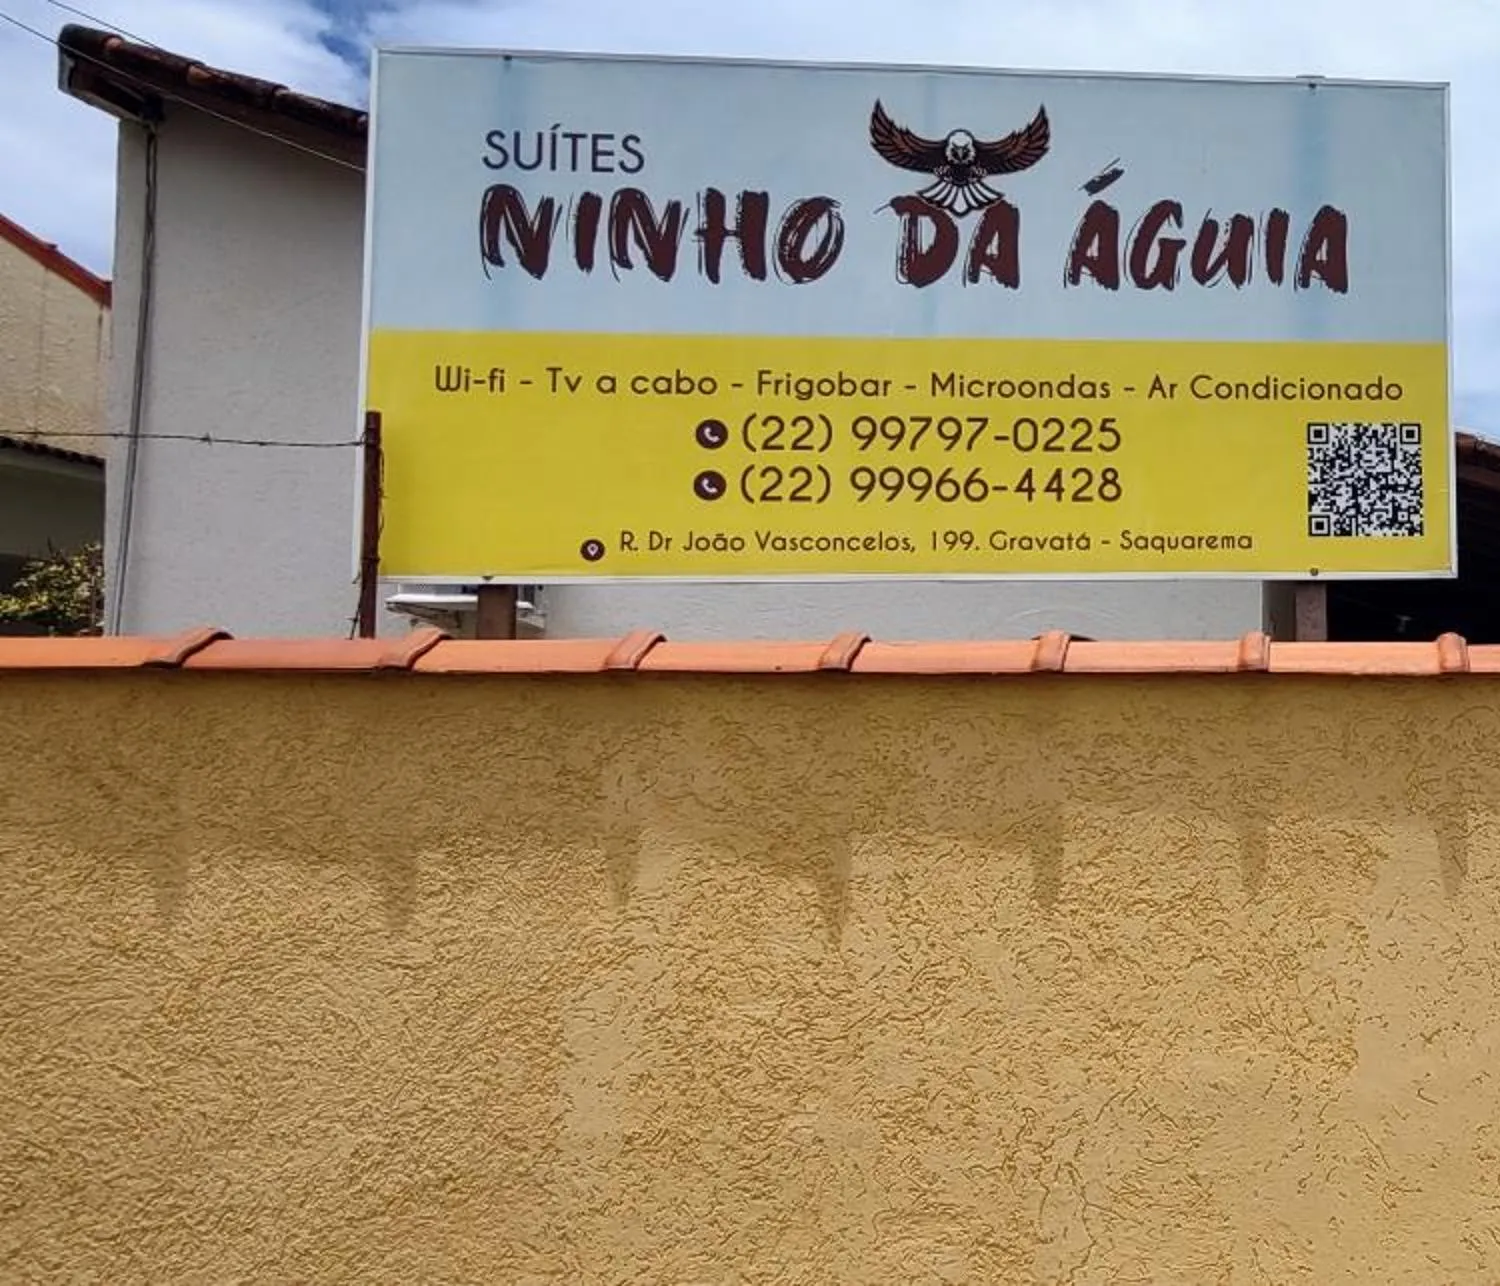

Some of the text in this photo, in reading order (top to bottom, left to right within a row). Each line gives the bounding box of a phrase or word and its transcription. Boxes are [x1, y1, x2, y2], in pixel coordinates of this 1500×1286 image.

[481, 123, 645, 174] SUÍTES
[479, 158, 1349, 295] NINHO DA ÁGUIA
[435, 365, 505, 393] Wi-fi
[545, 366, 583, 393] Tv
[595, 375, 617, 395] a
[630, 368, 718, 396] cabo
[757, 369, 892, 401] Frigobar
[931, 371, 1111, 399] Microondas
[1147, 374, 1178, 399] Ar
[1189, 374, 1403, 401] Condicionado
[741, 412, 1122, 453] (22) 99797-0225
[740, 463, 1123, 505] (22) 99966-4428
[619, 530, 639, 552] R.
[648, 530, 673, 552] Dr
[682, 530, 746, 552] João
[754, 530, 916, 553] Vasconcelos,
[932, 529, 980, 552] 199.
[989, 529, 1091, 551] Gravatá
[1119, 529, 1253, 555] Saquarema
